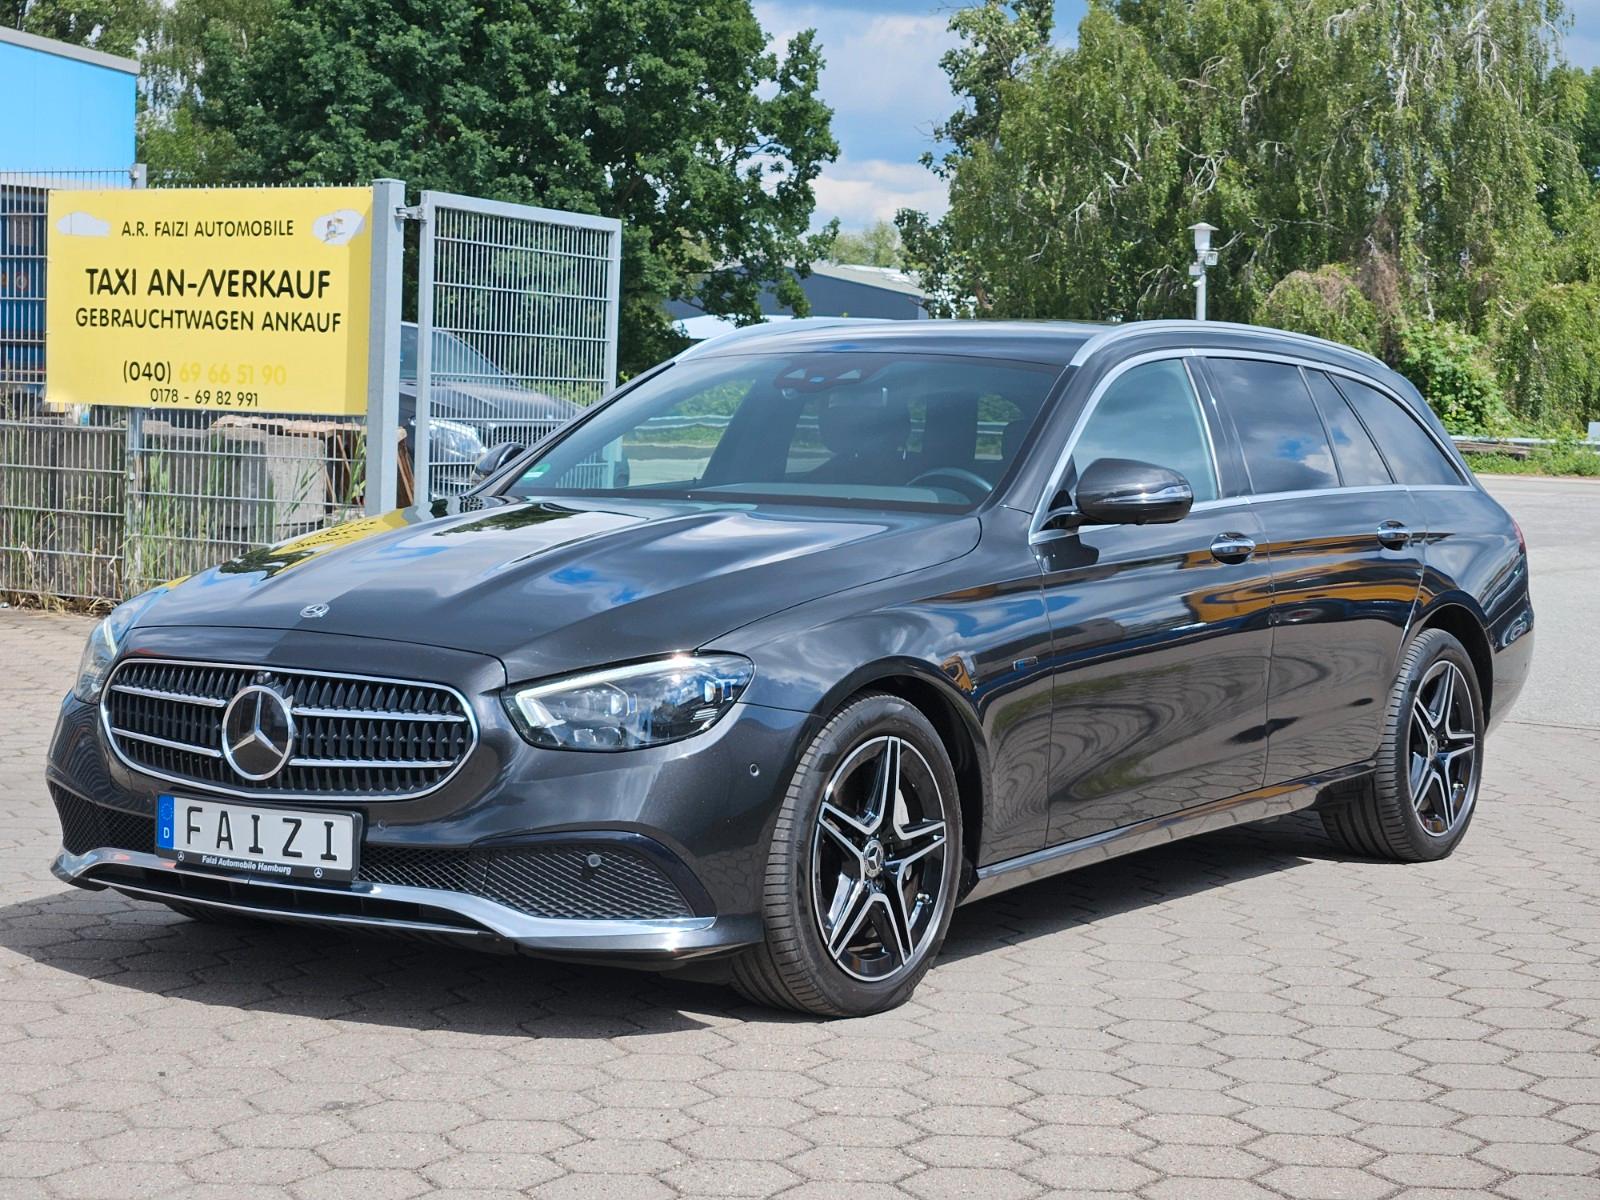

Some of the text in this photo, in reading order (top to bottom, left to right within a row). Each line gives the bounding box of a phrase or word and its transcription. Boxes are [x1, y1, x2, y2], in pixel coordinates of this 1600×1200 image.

[121, 220, 295, 237] A.R. FAIZI AUTOMOBILE
[85, 268, 331, 299] TAXI AN-/VERKAUF
[75, 307, 342, 333] GEBRAUCHTWAGEN ANKAUF
[122, 360, 288, 386] (040) 69 66 51 90
[150, 388, 179, 403] 0178
[194, 390, 211, 405] 69
[216, 391, 232, 406] 82
[237, 392, 258, 407] 991
[163, 826, 170, 839] D
[186, 806, 338, 861] FAIZI
[218, 858, 257, 870] Automobile
[257, 862, 292, 875] Hamburg
